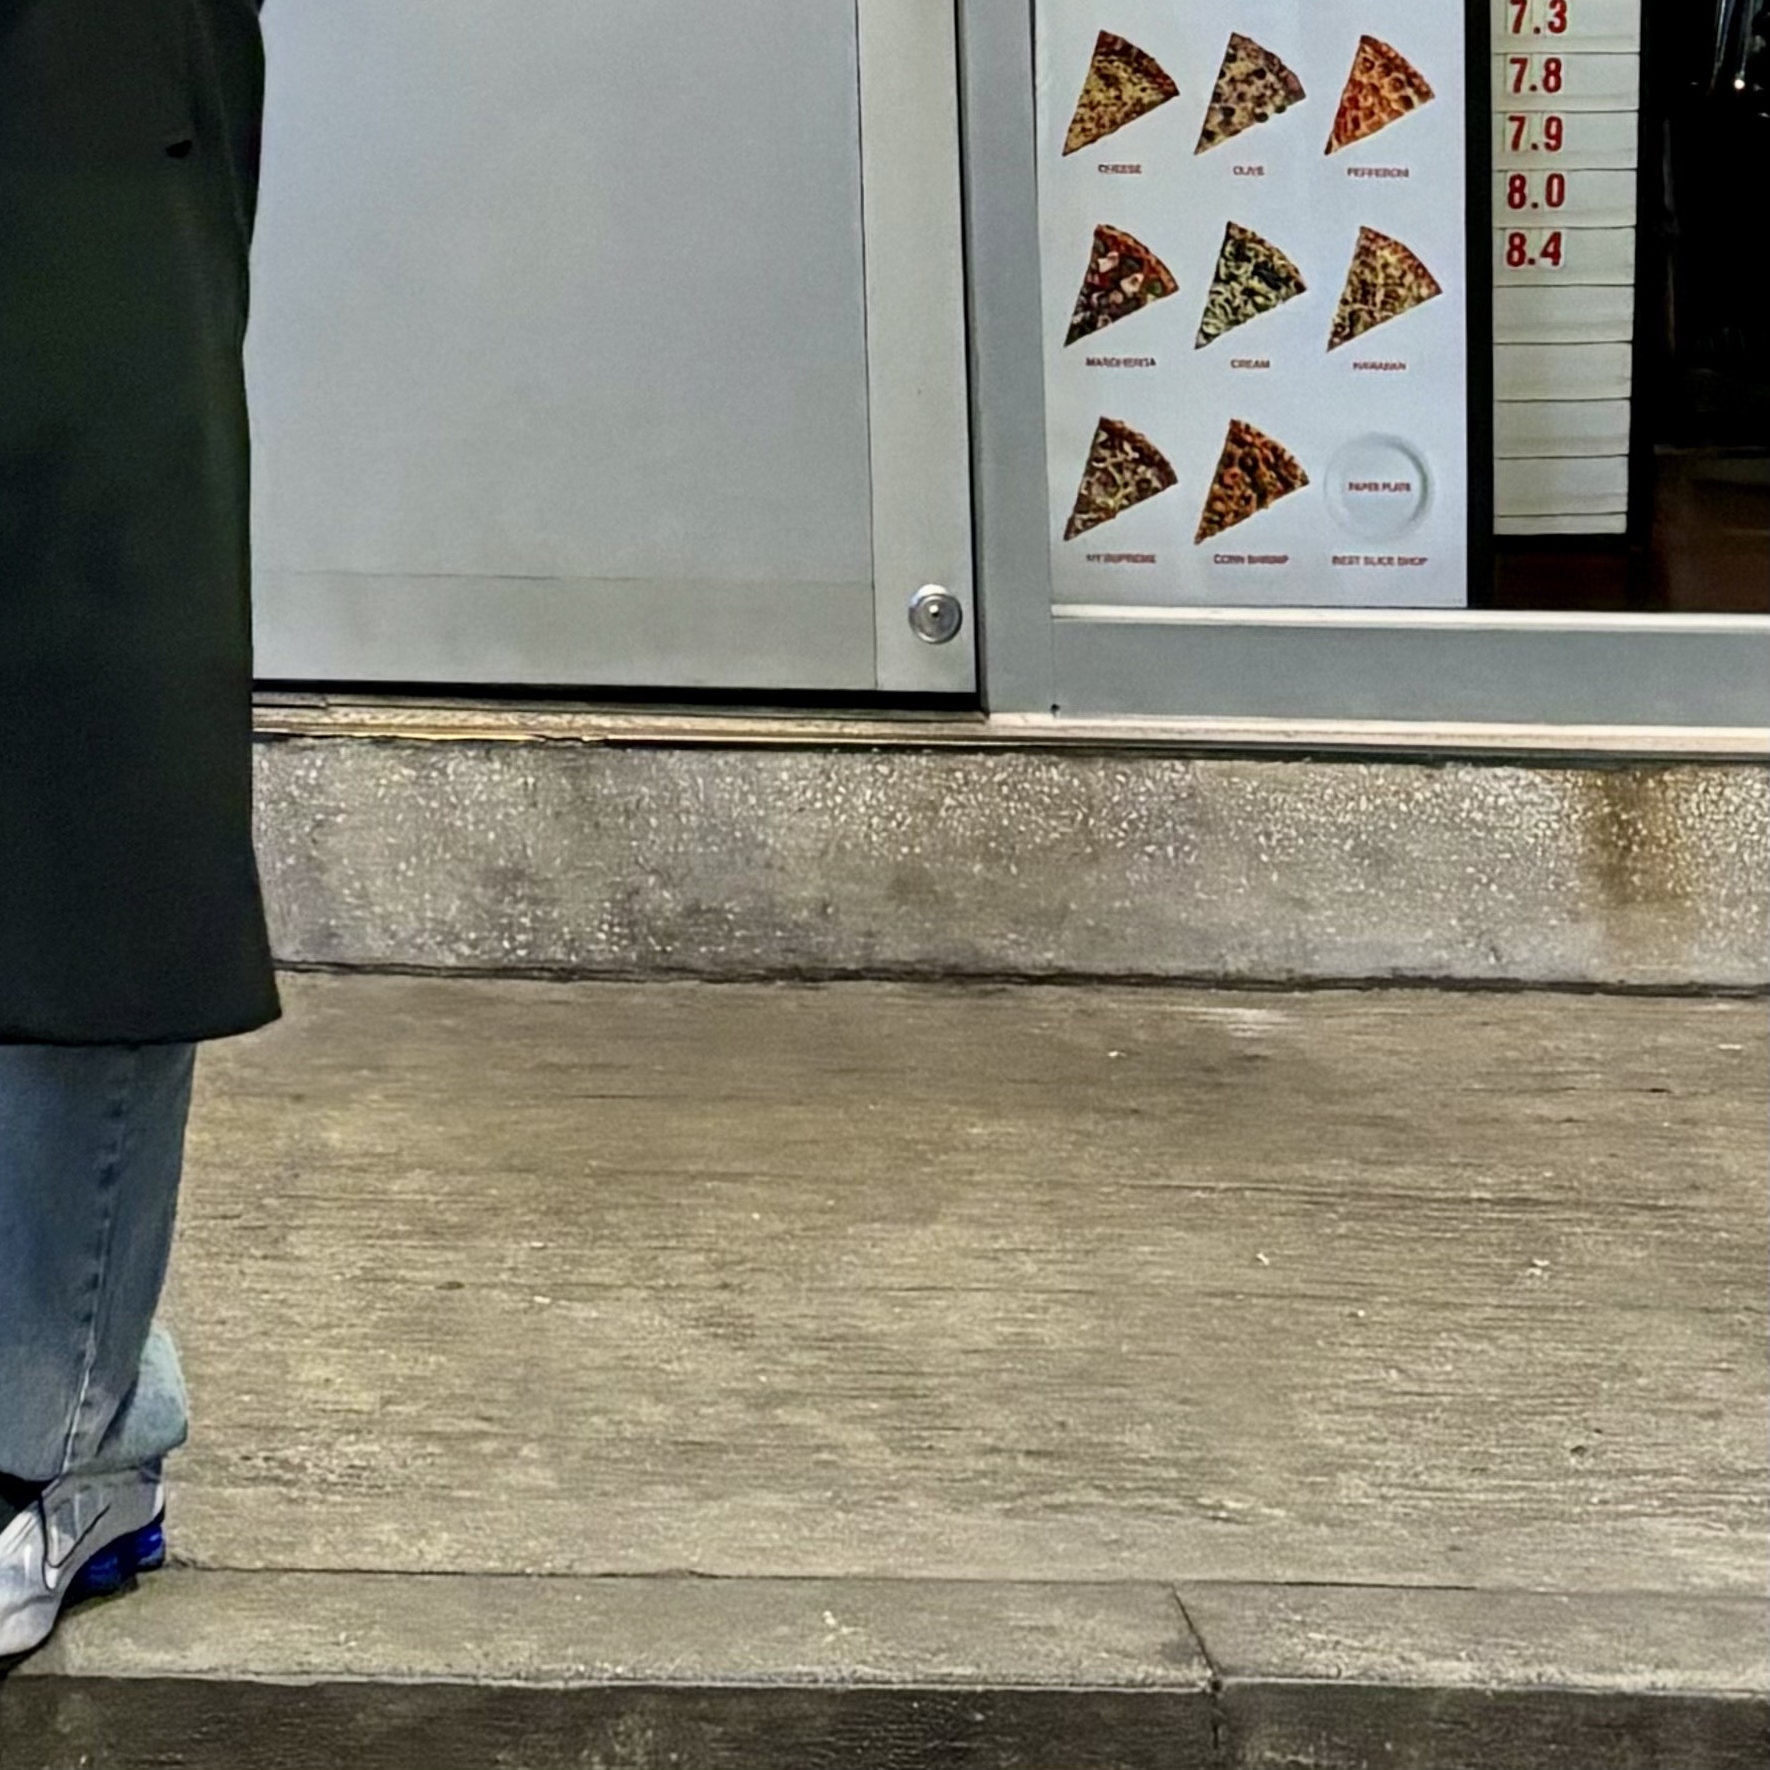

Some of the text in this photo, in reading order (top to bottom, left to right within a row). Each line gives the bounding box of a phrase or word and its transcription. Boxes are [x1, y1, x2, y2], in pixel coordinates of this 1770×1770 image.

[1509, 56, 1563, 94] 7.8
[1507, 115, 1564, 152] 7.9
[1232, 165, 1266, 177] OLIVE
[1506, 172, 1566, 210] 8.0
[1505, 231, 1563, 268] 8.4
[1229, 358, 1271, 370] CREAM
[1331, 555, 1361, 567] BEST
[1396, 556, 1429, 568] SHOP
